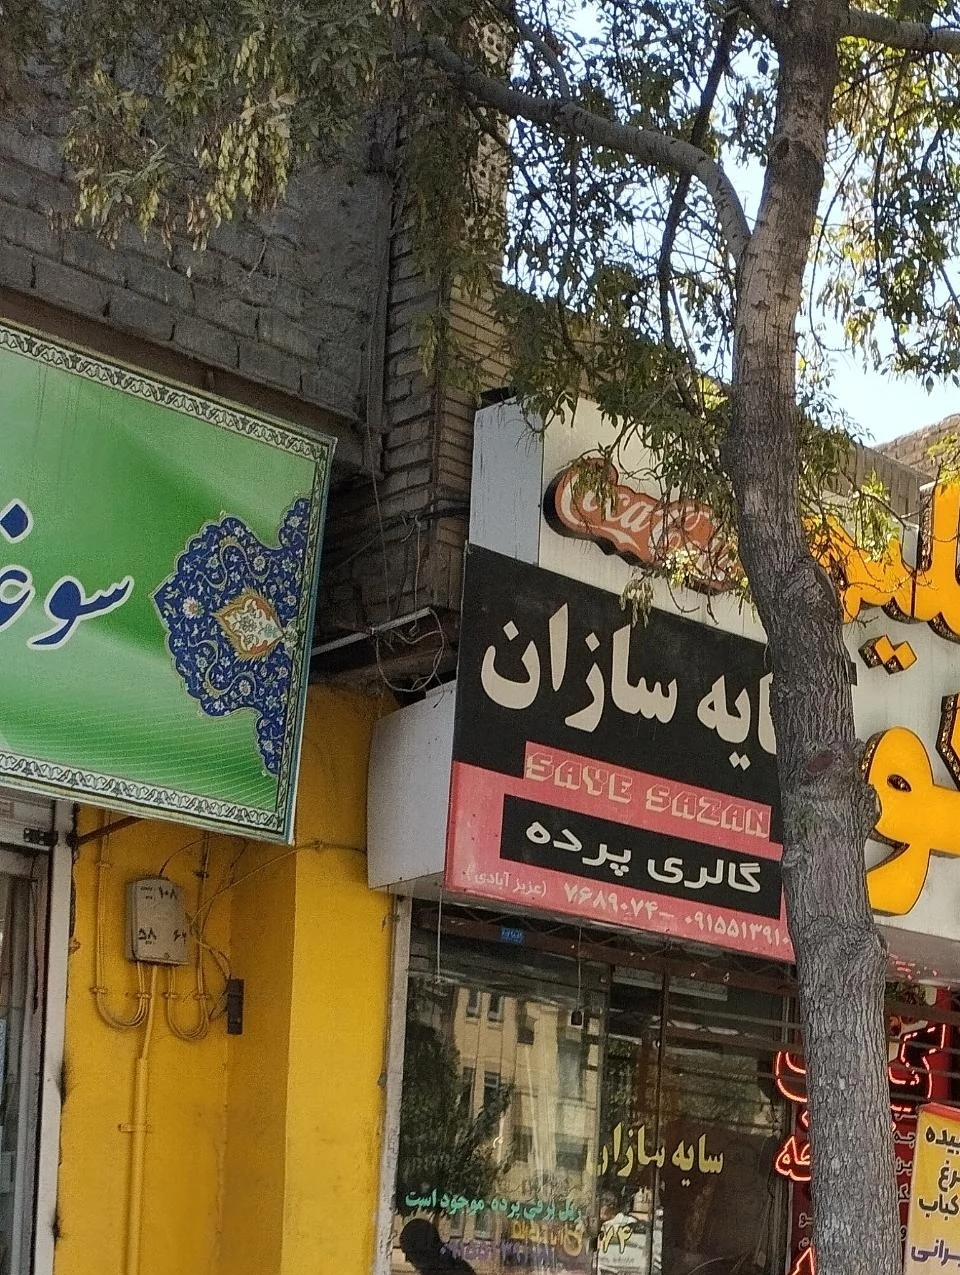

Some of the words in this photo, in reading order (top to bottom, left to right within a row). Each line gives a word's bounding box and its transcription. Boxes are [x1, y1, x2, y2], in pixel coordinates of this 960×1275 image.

[481, 602, 678, 733] سازان
[697, 672, 776, 771] ایه
[526, 752, 633, 804] SAYE
[645, 783, 771, 839] SAZAN
[526, 821, 632, 877] پرده
[648, 857, 761, 893] گالری
[685, 911, 790, 946] ۰۹۱۵۵۱۳۹۱۰
[672, 1133, 724, 1187] سایه
[405, 1188, 437, 1210] است
